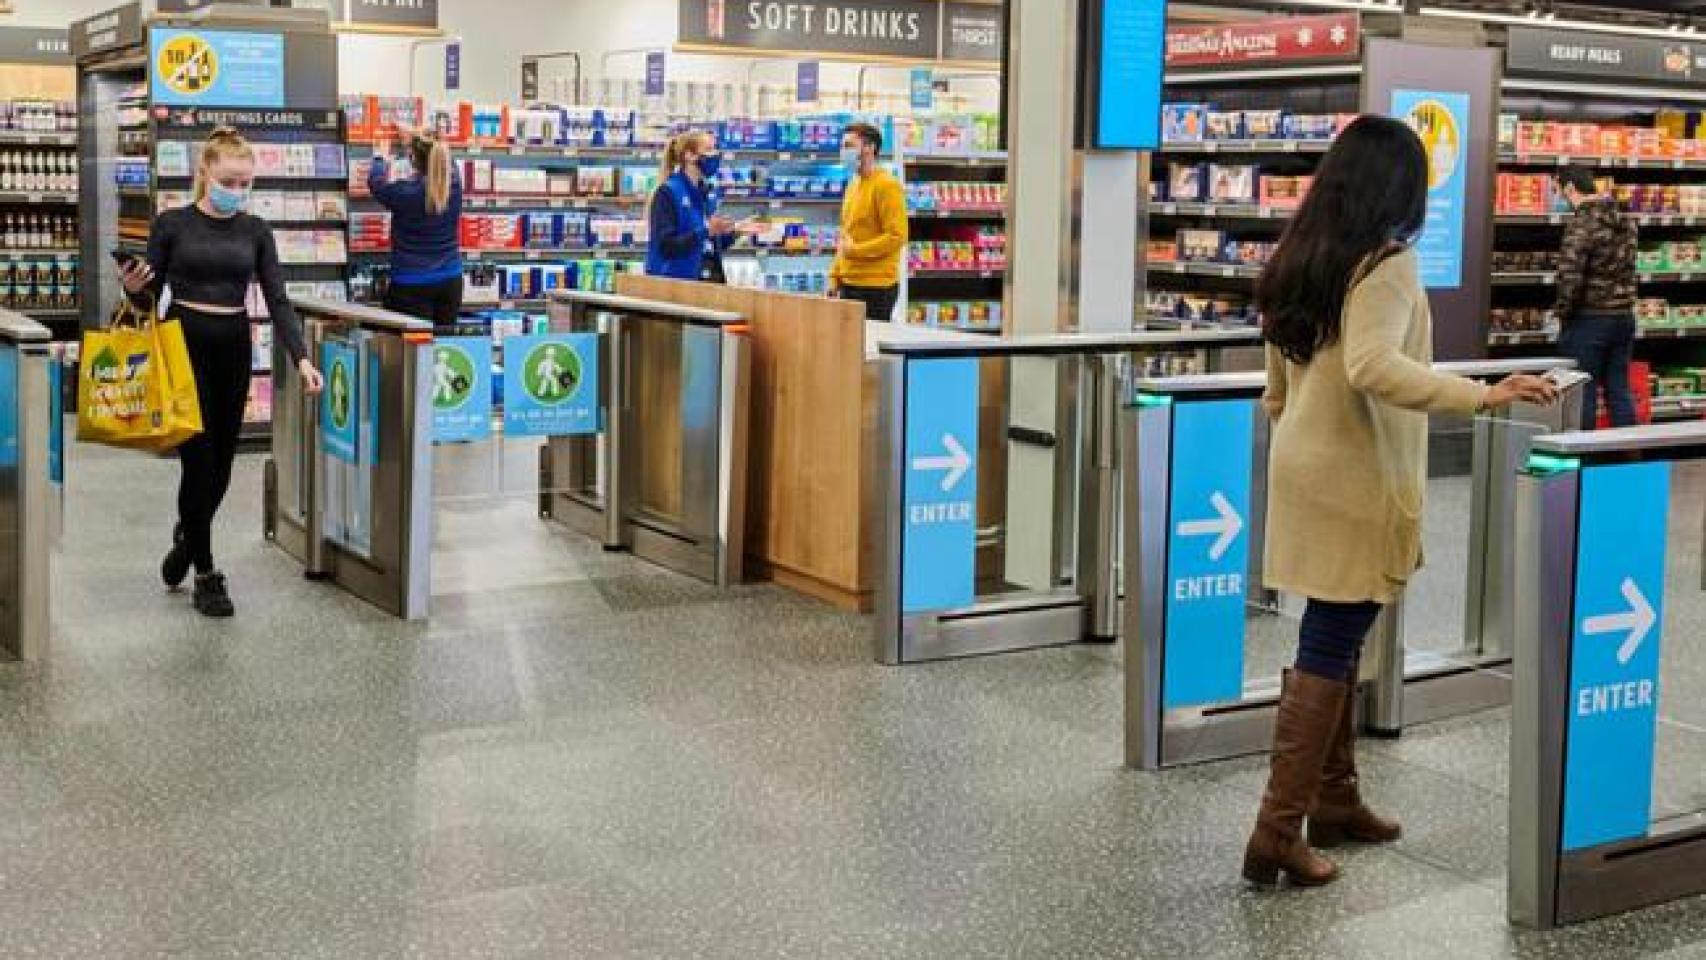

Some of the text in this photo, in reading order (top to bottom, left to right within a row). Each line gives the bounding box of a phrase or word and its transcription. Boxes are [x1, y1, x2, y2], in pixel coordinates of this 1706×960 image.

[749, 2, 816, 33] SOFT
[825, 7, 920, 40] DRINKS
[199, 111, 303, 125] GREETINGS CARDS
[910, 501, 969, 523] ENTER
[1175, 574, 1241, 599] ENTER
[1578, 679, 1652, 716] ENTER
